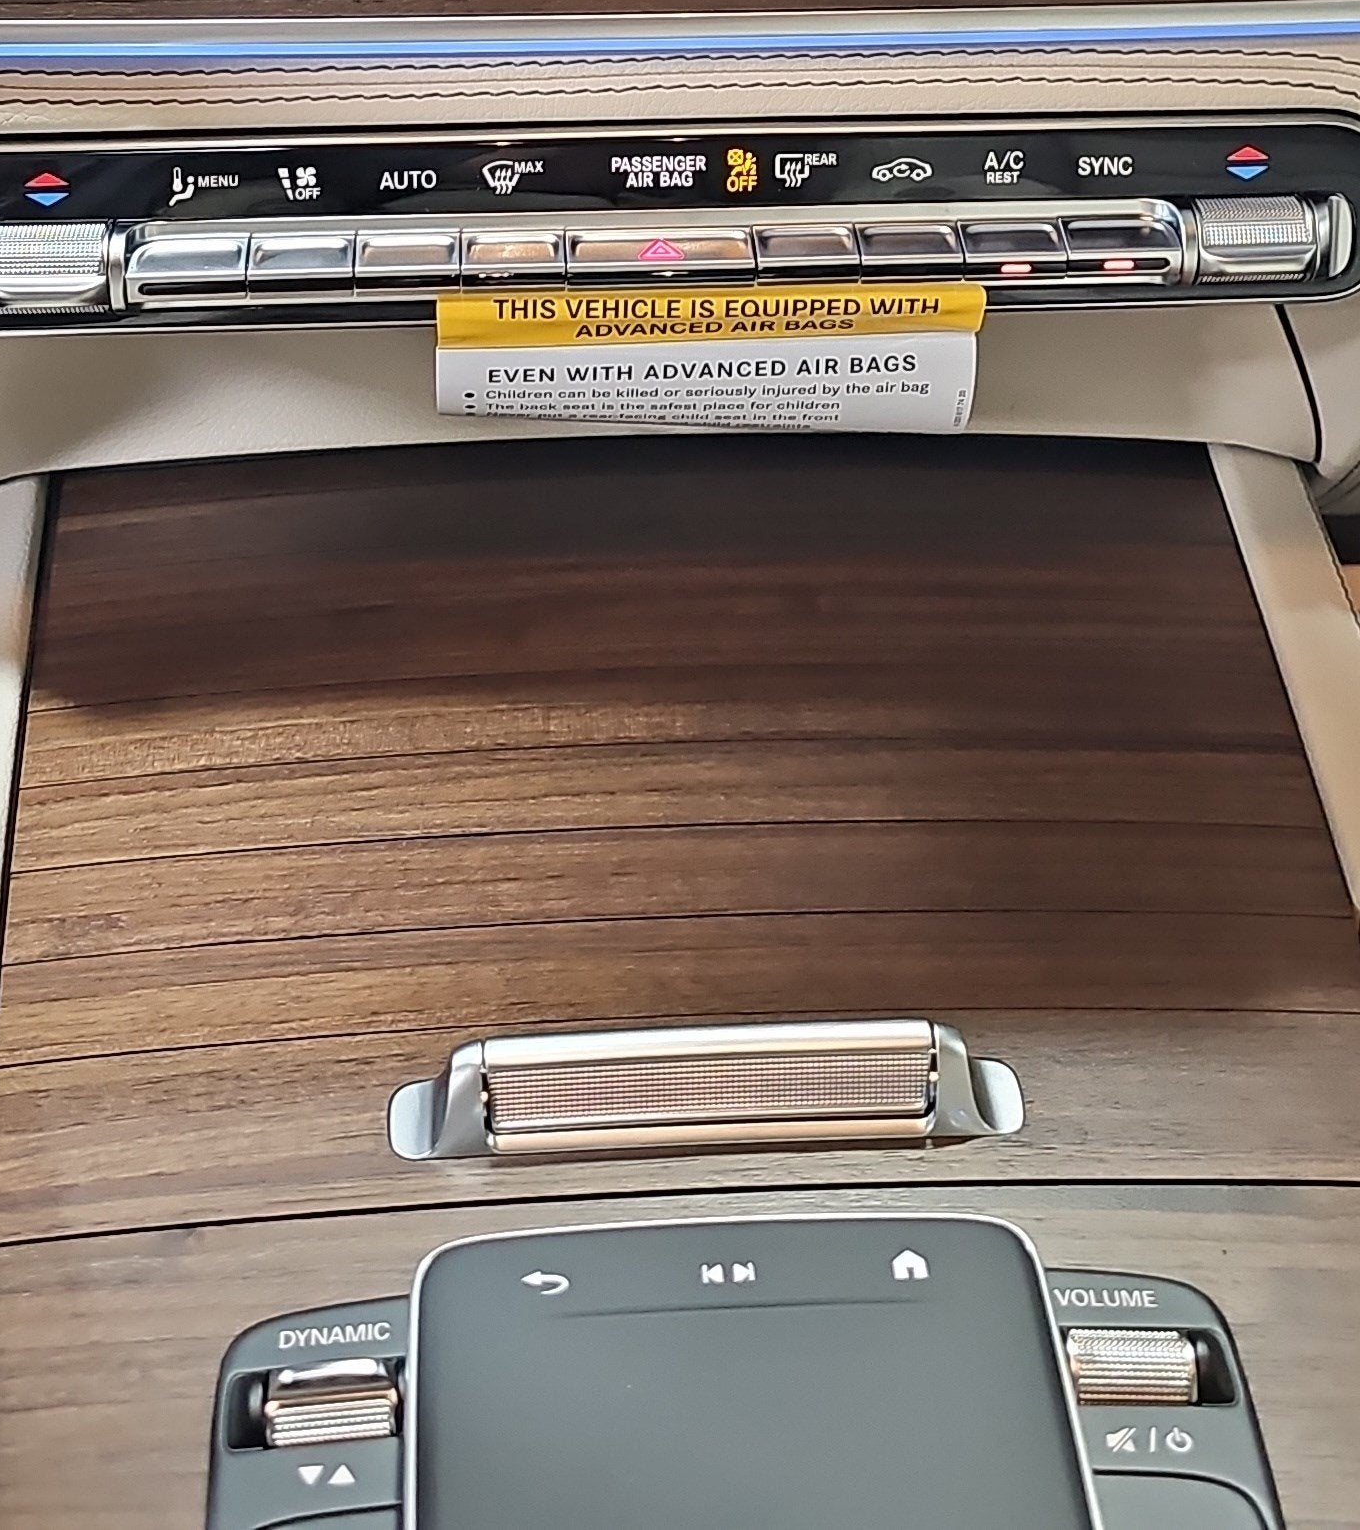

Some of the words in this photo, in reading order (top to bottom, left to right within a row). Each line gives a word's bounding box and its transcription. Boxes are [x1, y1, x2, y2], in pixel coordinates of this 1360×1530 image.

[514, 161, 544, 174] MAX
[611, 155, 706, 173] PASSENGER
[804, 153, 837, 165] REAR
[984, 150, 1024, 170] A/C
[1077, 156, 1133, 176] SYNC
[197, 175, 239, 188] MENU
[380, 170, 437, 190] AUTO
[626, 172, 654, 188] AIR
[659, 172, 693, 187] BAG
[726, 176, 758, 192] OFF
[986, 171, 1020, 184] REST
[295, 188, 321, 200] OFF
[492, 299, 556, 320] THIS
[565, 298, 681, 320] VEHICLE
[690, 298, 715, 319] IS
[725, 298, 861, 319] EQUIPPED
[870, 297, 940, 315] WITH
[575, 321, 723, 338] ADVANCED
[731, 321, 775, 333] AIR
[784, 318, 854, 331] BAGS
[488, 368, 556, 384] EVEN
[566, 365, 633, 382] WITH
[643, 359, 787, 380] ADVANCED
[796, 358, 840, 375] AIR
[849, 354, 917, 374] BAGS
[485, 389, 553, 399] Children
[558, 390, 586, 399] can
[591, 388, 611, 399] be
[616, 387, 659, 398] killed
[663, 389, 681, 398] or
[685, 386, 757, 399] seriously
[761, 384, 817, 398] injured
[822, 383, 841, 397] by
[846, 382, 871, 395] the
[875, 381, 897, 394] air
[901, 381, 930, 395] bag
[486, 402, 515, 411] The
[620, 401, 645, 411] the
[702, 401, 745, 412] place
[750, 401, 773, 411] for
[776, 400, 840, 411] children
[1053, 1288, 1159, 1308] VOLUME
[278, 1321, 392, 1349] DYNAMIC
